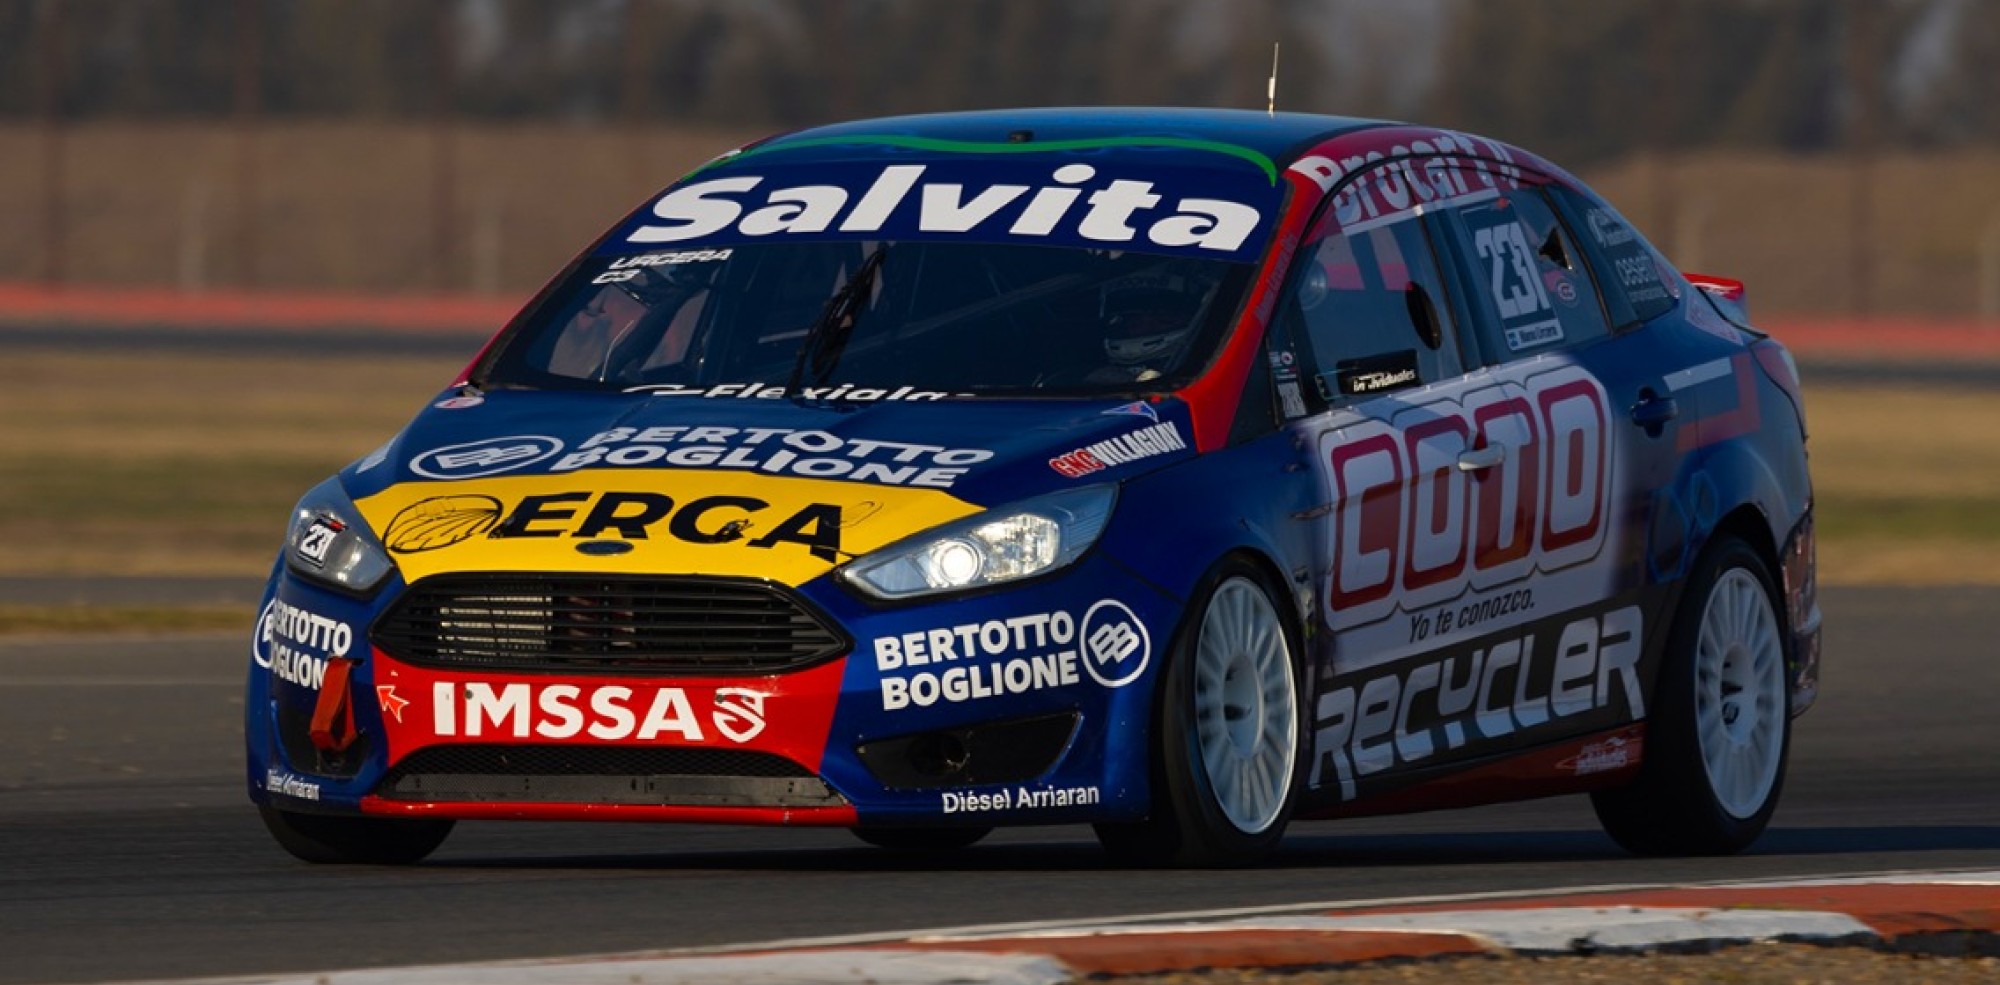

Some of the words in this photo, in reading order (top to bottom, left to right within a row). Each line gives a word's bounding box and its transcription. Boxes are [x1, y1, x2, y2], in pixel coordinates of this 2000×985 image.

[626, 163, 1262, 252] Salvita
[1287, 134, 1497, 227] Brocart
[590, 268, 642, 285] C3
[608, 248, 735, 270] URCERA
[1474, 220, 1551, 320] 231
[548, 444, 971, 488] BOGLIONE
[578, 425, 995, 465] BERTOTTO
[1329, 378, 1606, 613] COTO
[299, 522, 338, 562] 231
[874, 610, 1075, 671] BERTOTTO
[1409, 613, 1430, 644] Yo
[1434, 607, 1454, 636] te
[1457, 588, 1536, 629] conozco.
[880, 650, 1081, 711] BOGLIONE
[432, 680, 704, 741] IMSSA
[941, 787, 1012, 814] Diésel
[1016, 784, 1100, 809] Arriaran
